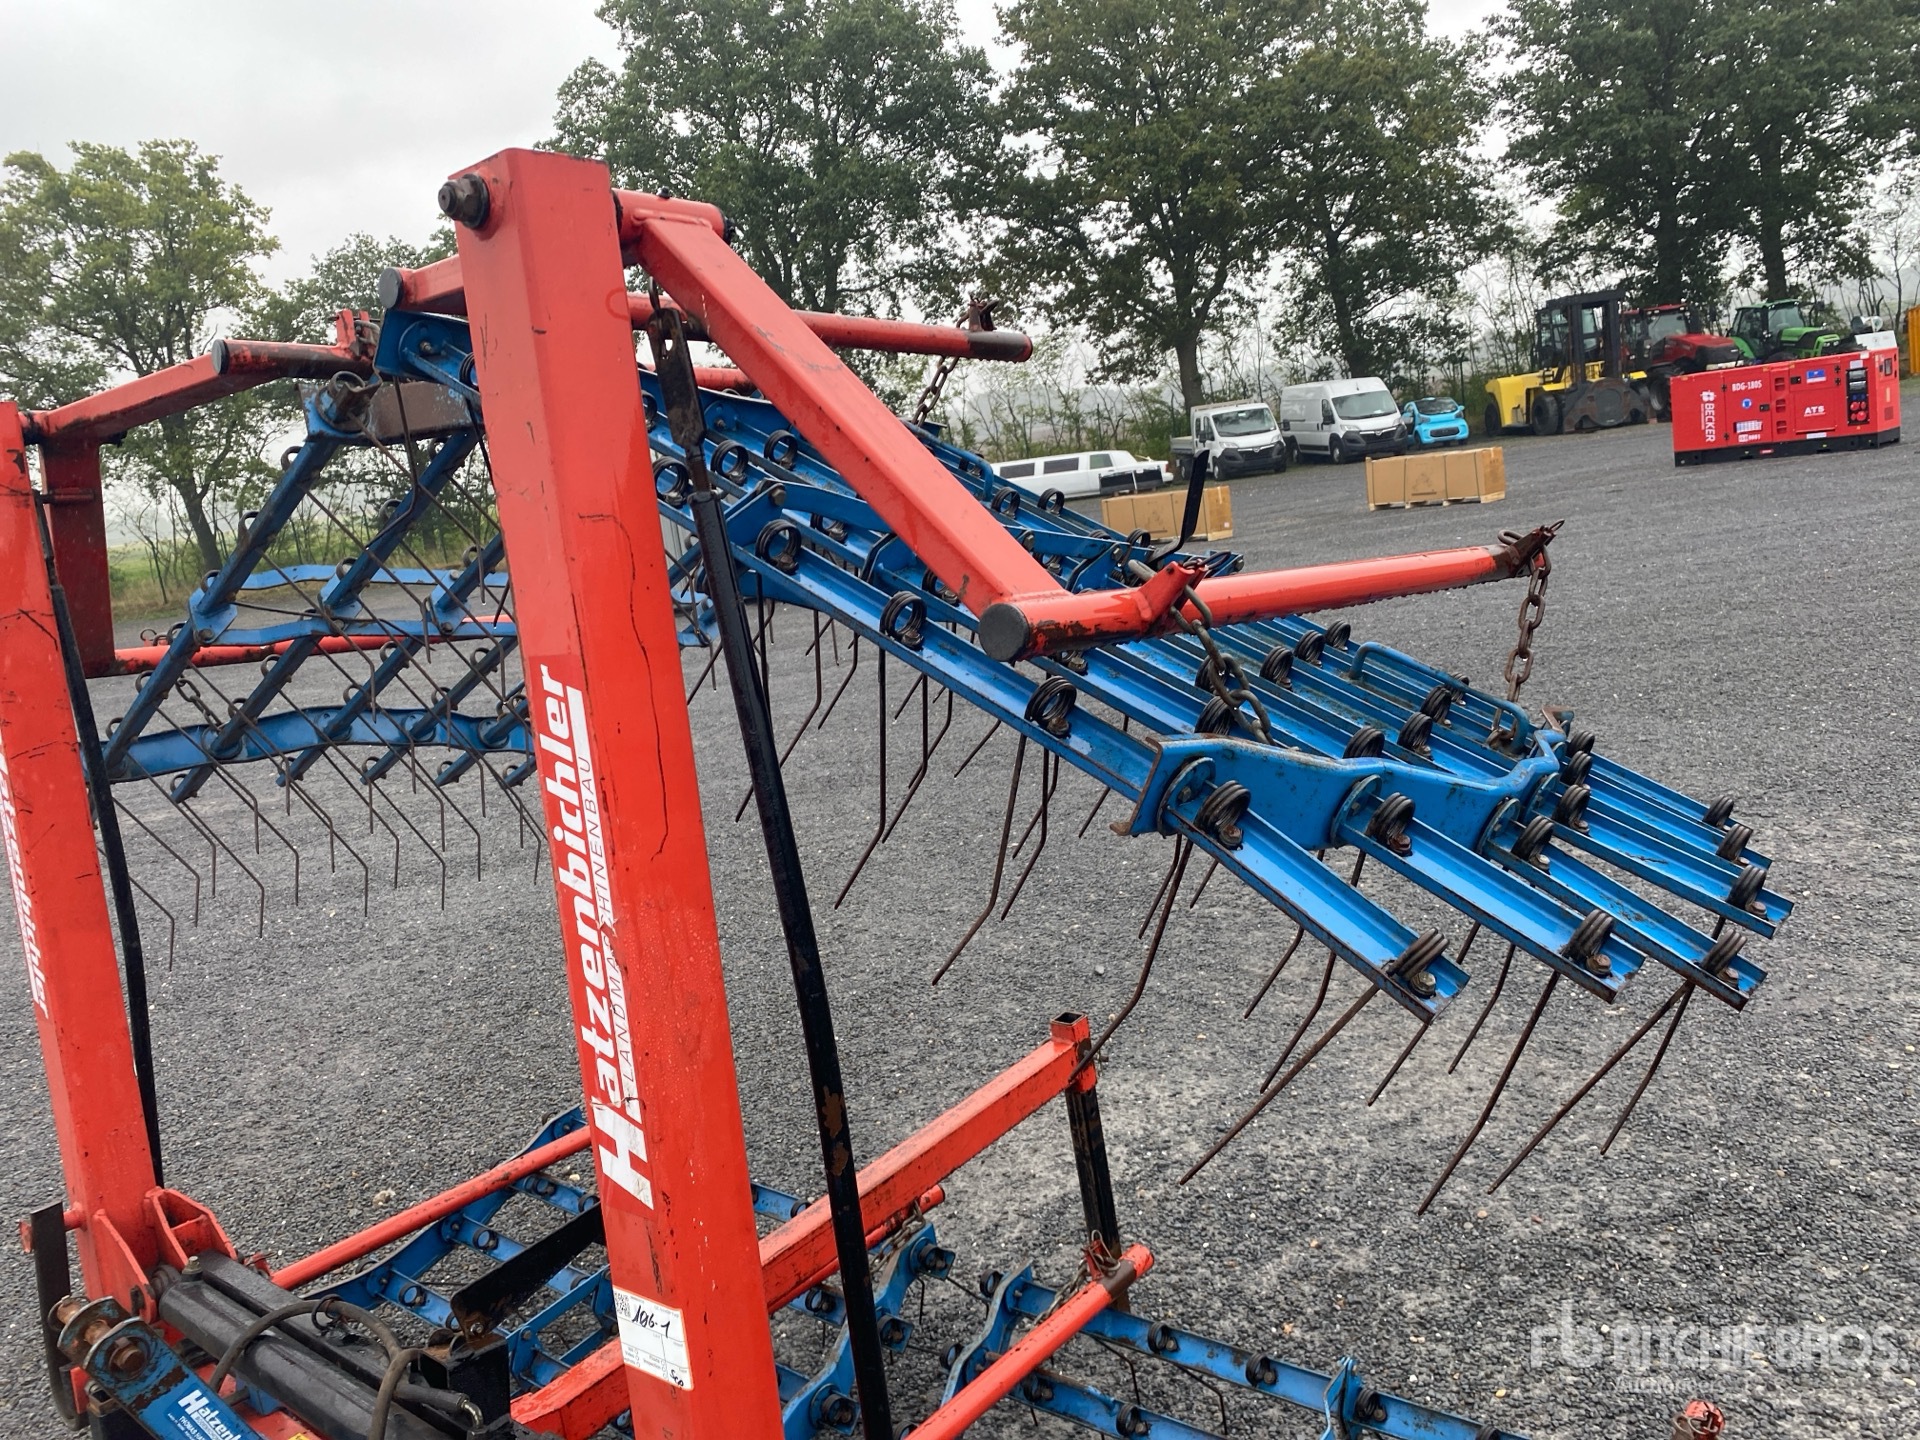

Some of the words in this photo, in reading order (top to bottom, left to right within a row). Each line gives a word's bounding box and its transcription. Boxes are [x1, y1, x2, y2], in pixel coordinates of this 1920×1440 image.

[1704, 403, 1716, 443] BECKER
[1804, 405, 1825, 415] ATS
[539, 663, 654, 1210] Hatzenbichler
[179, 1415, 198, 1435] THOMAS
